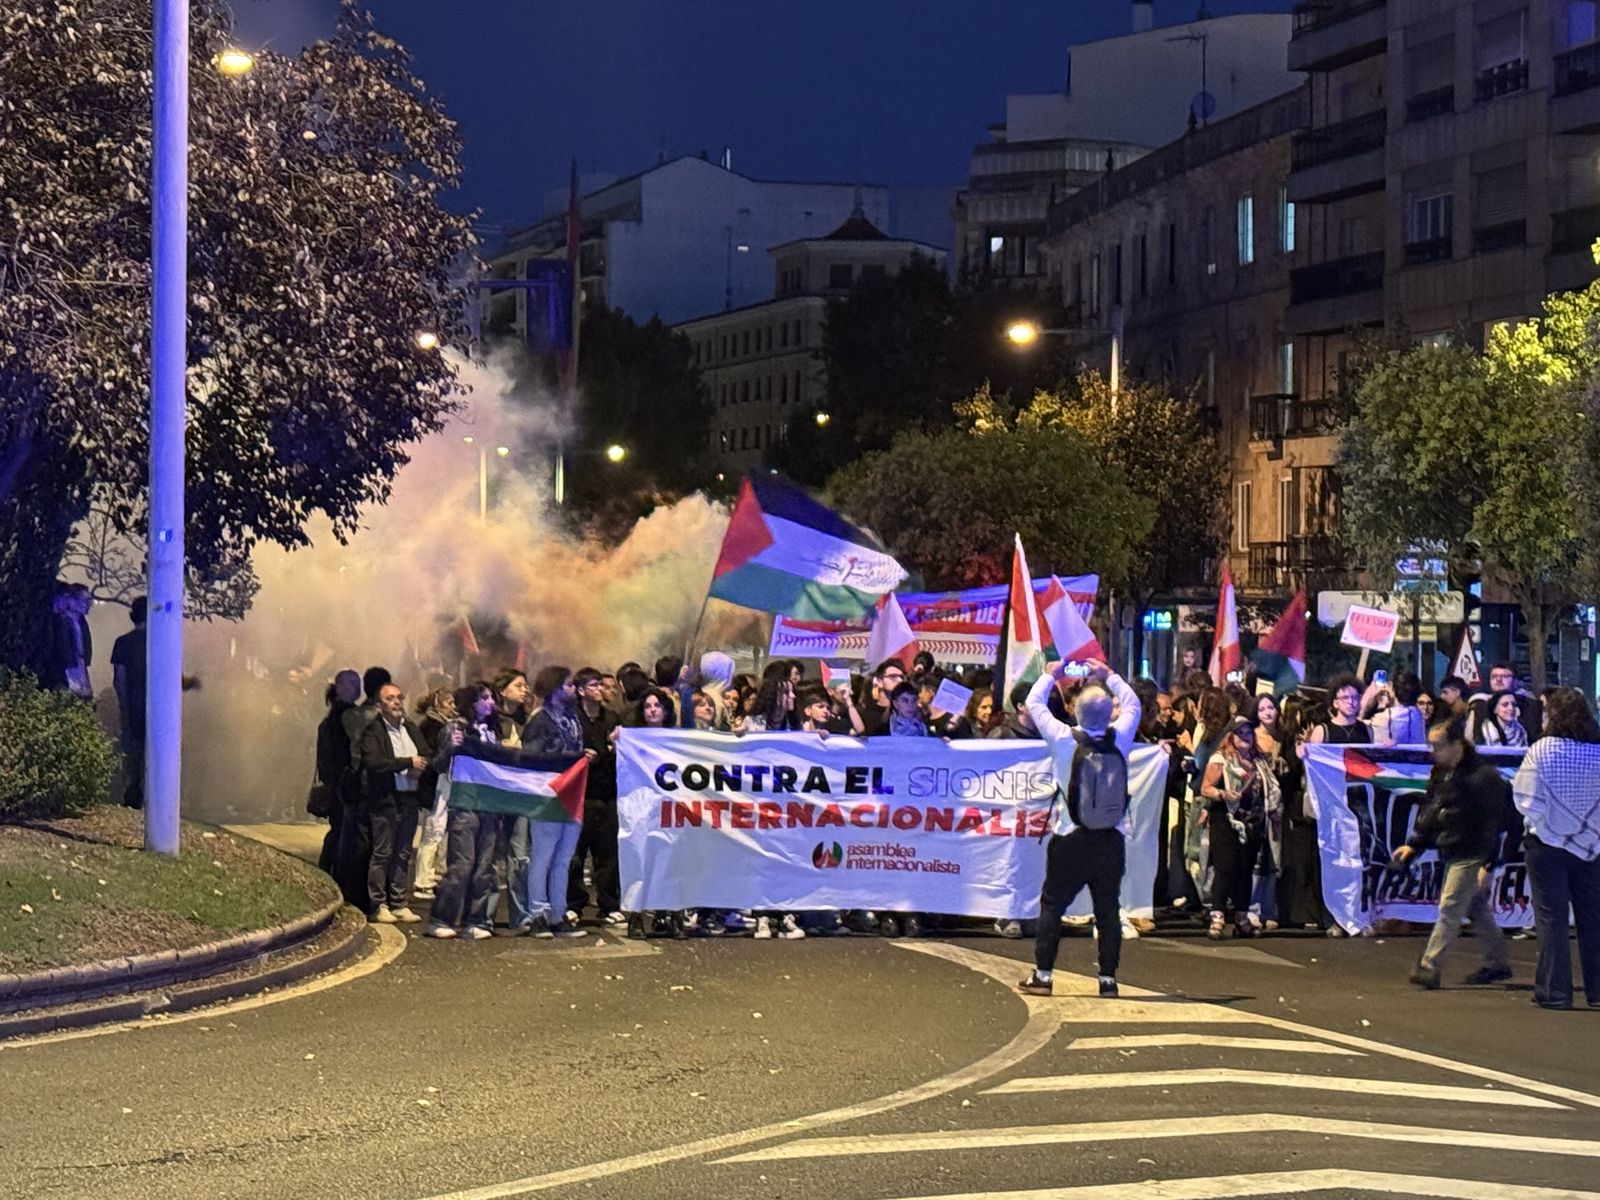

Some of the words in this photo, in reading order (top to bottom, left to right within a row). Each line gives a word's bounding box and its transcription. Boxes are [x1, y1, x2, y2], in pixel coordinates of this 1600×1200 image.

[654, 762, 831, 794] CONTRA
[844, 766, 894, 795] EL
[908, 766, 1054, 801] SIONIS
[660, 800, 1056, 838] INTERNACIONALIS
[846, 842, 916, 858] asamblea
[846, 856, 961, 874] internacionalista
